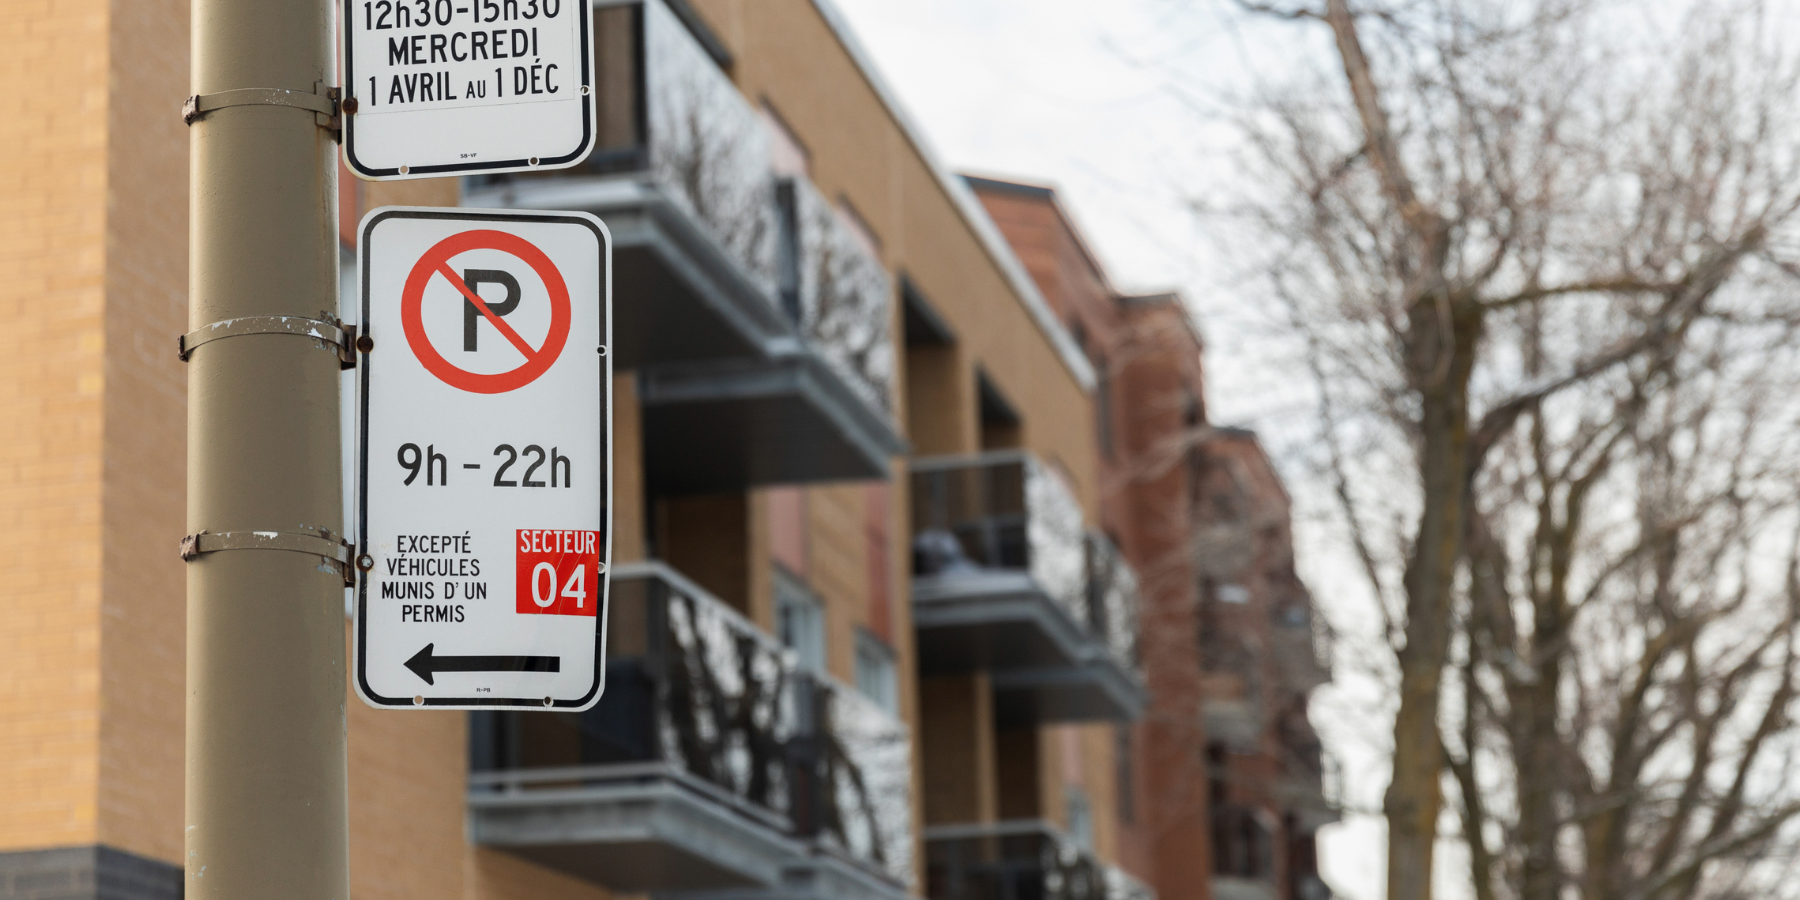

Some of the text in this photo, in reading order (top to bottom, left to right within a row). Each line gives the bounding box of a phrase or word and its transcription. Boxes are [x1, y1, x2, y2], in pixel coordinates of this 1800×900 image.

[364, 0, 560, 30] 12h30-15h30
[388, 27, 538, 66] MERCREDI
[369, 58, 558, 106] 1 AVRIL AU 1 DÉC
[398, 443, 446, 486] 9h
[494, 444, 570, 488] 22h
[398, 531, 471, 553] EXCEPTÉ
[520, 530, 596, 554] SECTEUR
[387, 554, 480, 576] VÉHICULES
[382, 582, 434, 599] MUNIS
[465, 582, 486, 599] UN
[532, 562, 586, 608] 04
[403, 605, 464, 622] PERMIS
